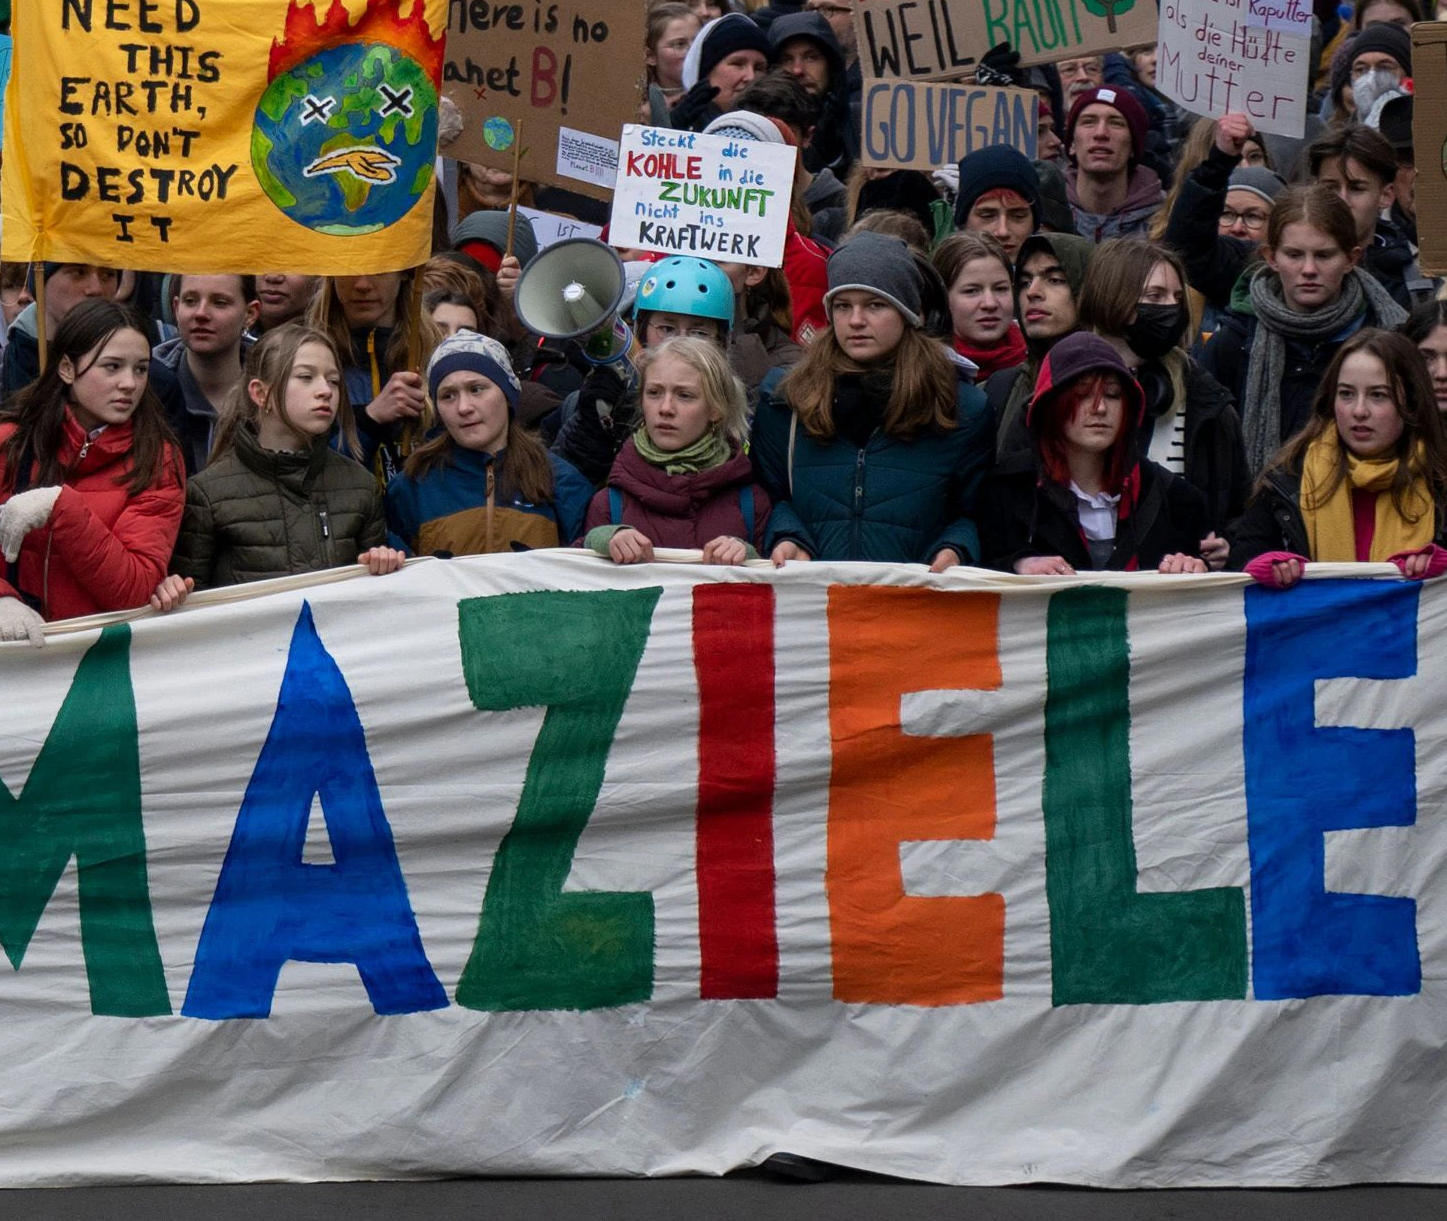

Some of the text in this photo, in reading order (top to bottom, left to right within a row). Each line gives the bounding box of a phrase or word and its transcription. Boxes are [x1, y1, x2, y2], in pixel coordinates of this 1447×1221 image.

[572, 14, 609, 44] no
[1195, 13, 1221, 45] die
[118, 43, 224, 83] THIS
[444, 56, 521, 97] anet
[1197, 46, 1245, 72] deiner
[58, 76, 207, 120] EARTH,
[1161, 42, 1294, 120] Mutter
[59, 122, 201, 159] SO DON'T
[865, 83, 1039, 165] GO VEGAN
[641, 129, 749, 158] Steckt die
[60, 162, 238, 205] DESTROY
[627, 151, 702, 180] KOHLE
[718, 164, 733, 181] in
[739, 170, 764, 186] die
[635, 202, 724, 228] nicht ins
[658, 181, 775, 217] ZUKUNFT
[111, 214, 173, 243] IT
[639, 220, 761, 258] KRAFTWERK
